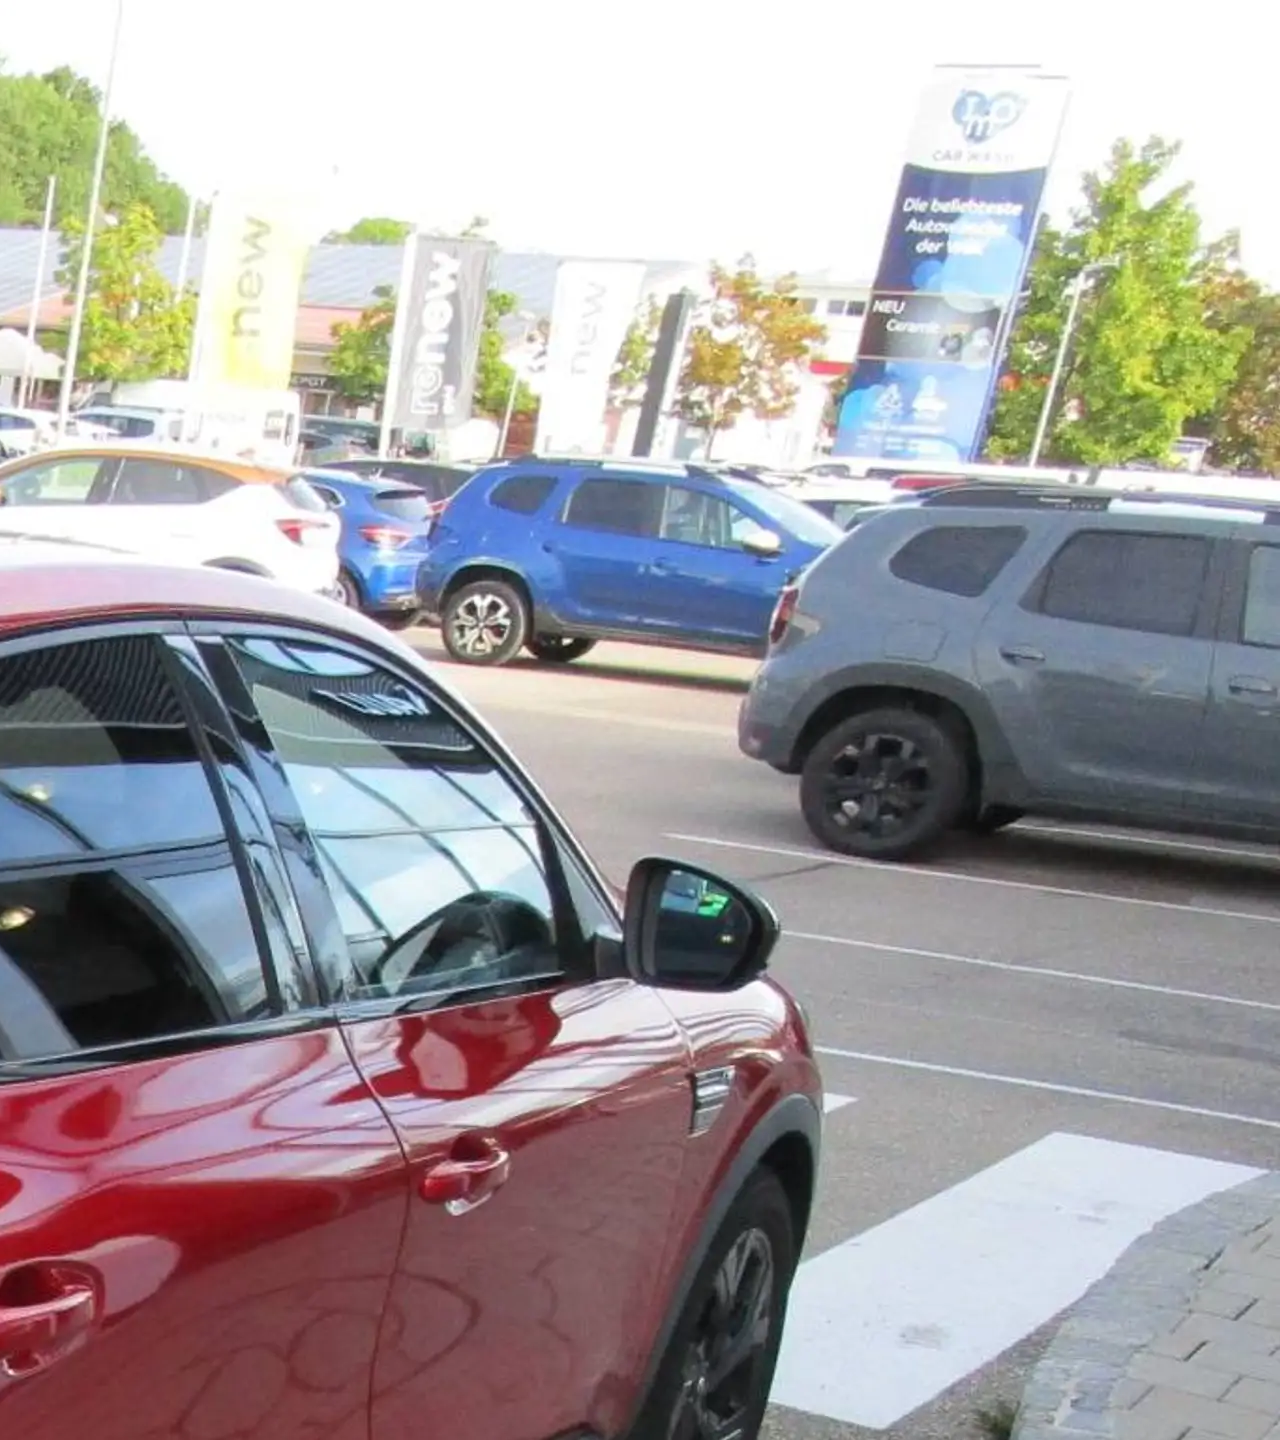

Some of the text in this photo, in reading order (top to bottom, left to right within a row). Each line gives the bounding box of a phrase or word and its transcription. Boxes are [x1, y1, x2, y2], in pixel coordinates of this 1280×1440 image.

[902, 197, 929, 212] Die
[915, 238, 945, 254] der
[231, 214, 273, 338] new
[872, 299, 906, 314] NEU
